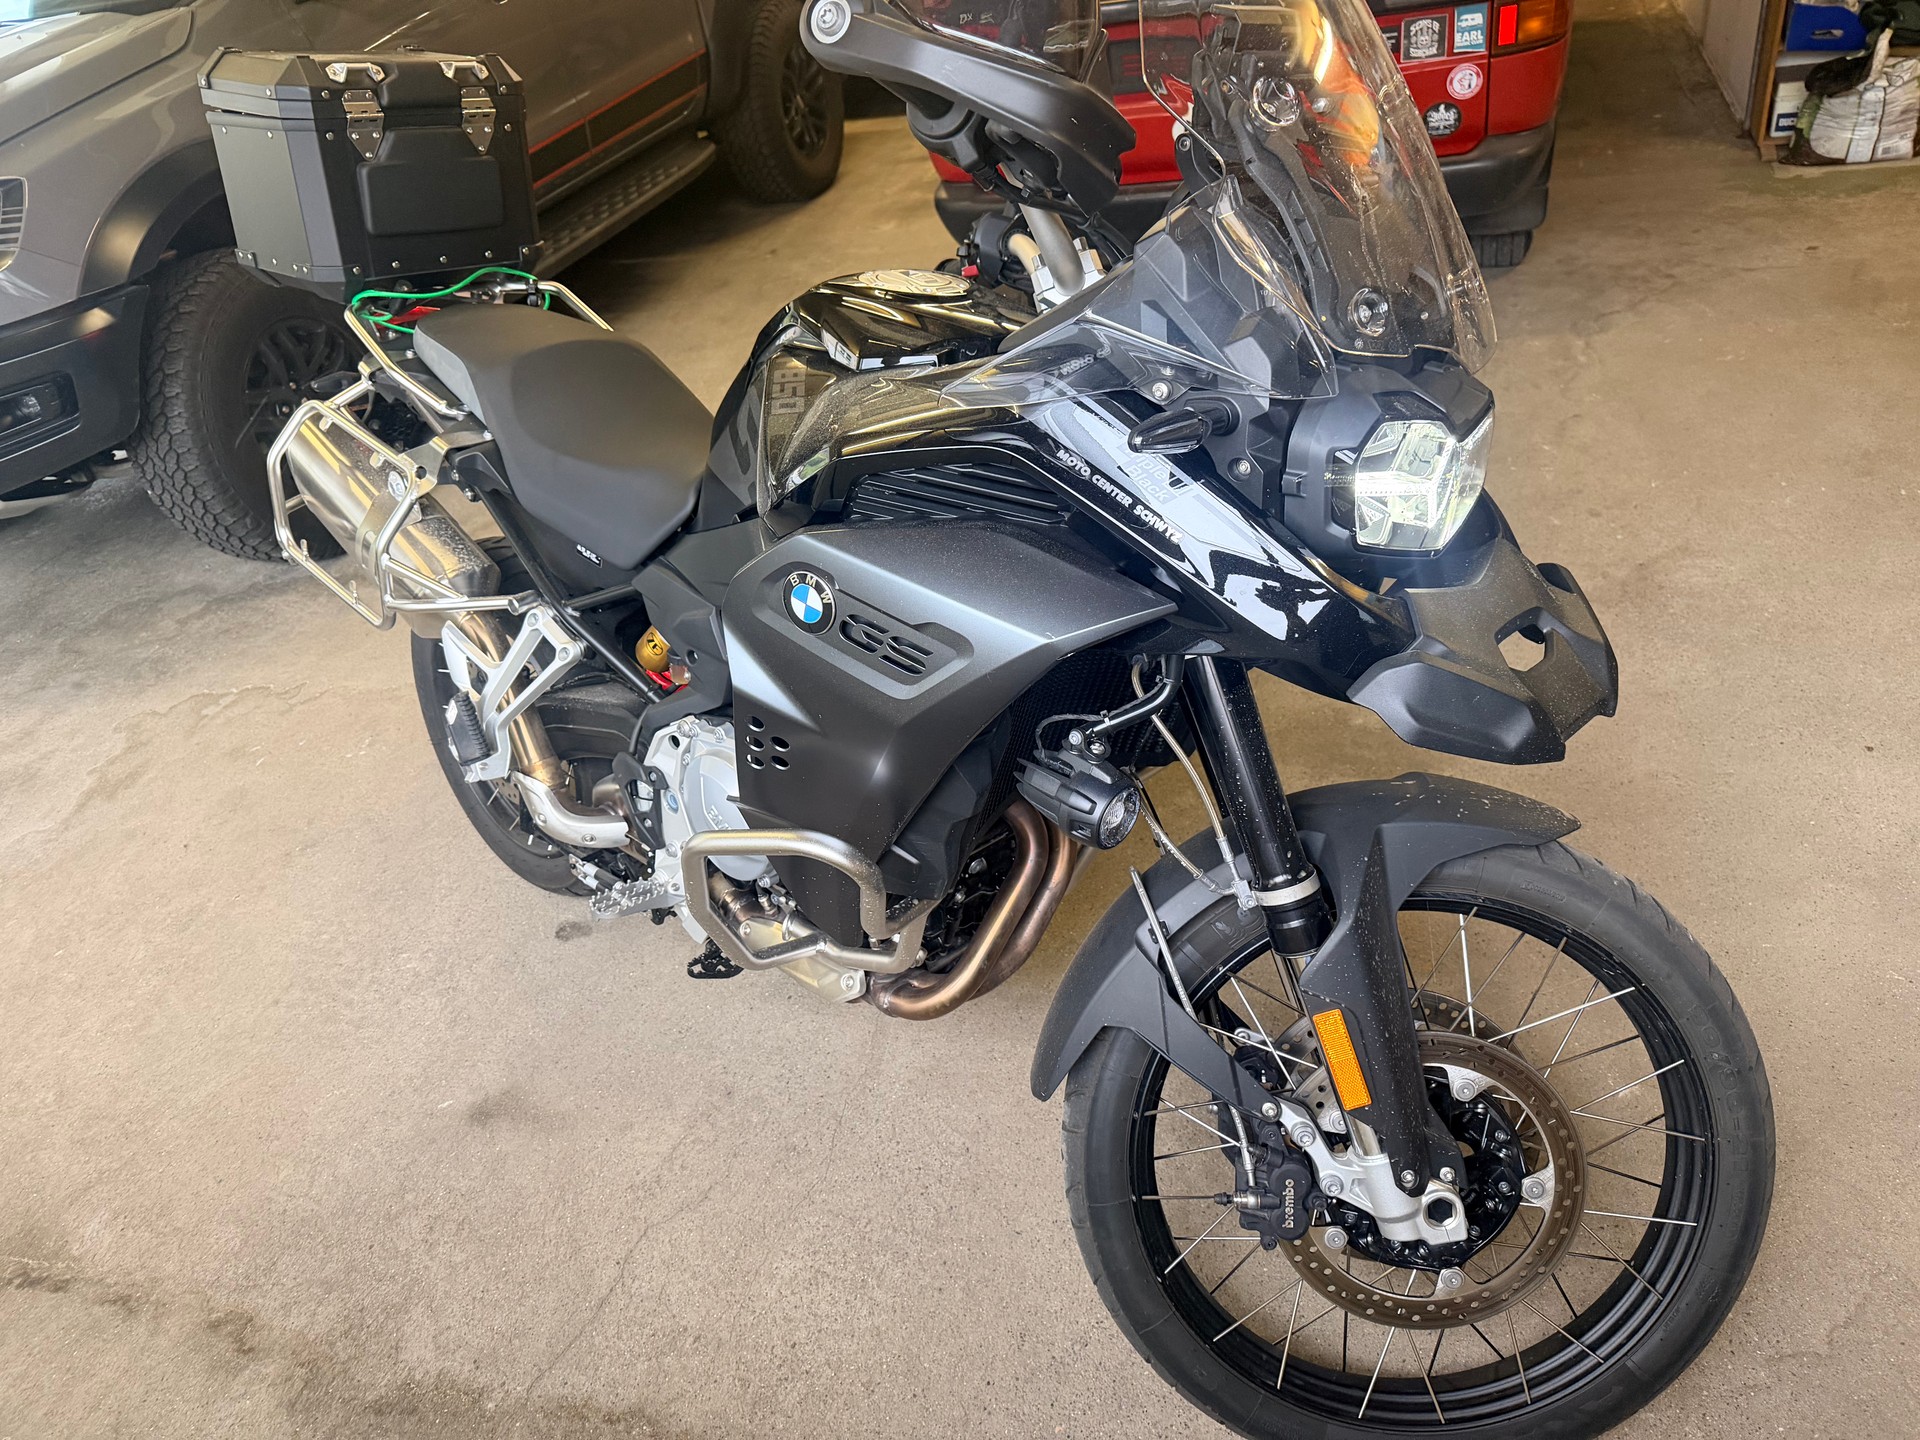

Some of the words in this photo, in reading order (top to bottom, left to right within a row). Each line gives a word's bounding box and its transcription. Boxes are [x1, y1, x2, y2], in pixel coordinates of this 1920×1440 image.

[1456, 30, 1484, 44] EARL
[1056, 449, 1091, 478] MOTO
[1091, 474, 1133, 508] CENTER
[1133, 504, 1184, 544] SCHWYZ
[1125, 464, 1171, 502] Black
[789, 573, 832, 604] BMW
[838, 613, 934, 677] GS
[1281, 1178, 1295, 1229] brembo
